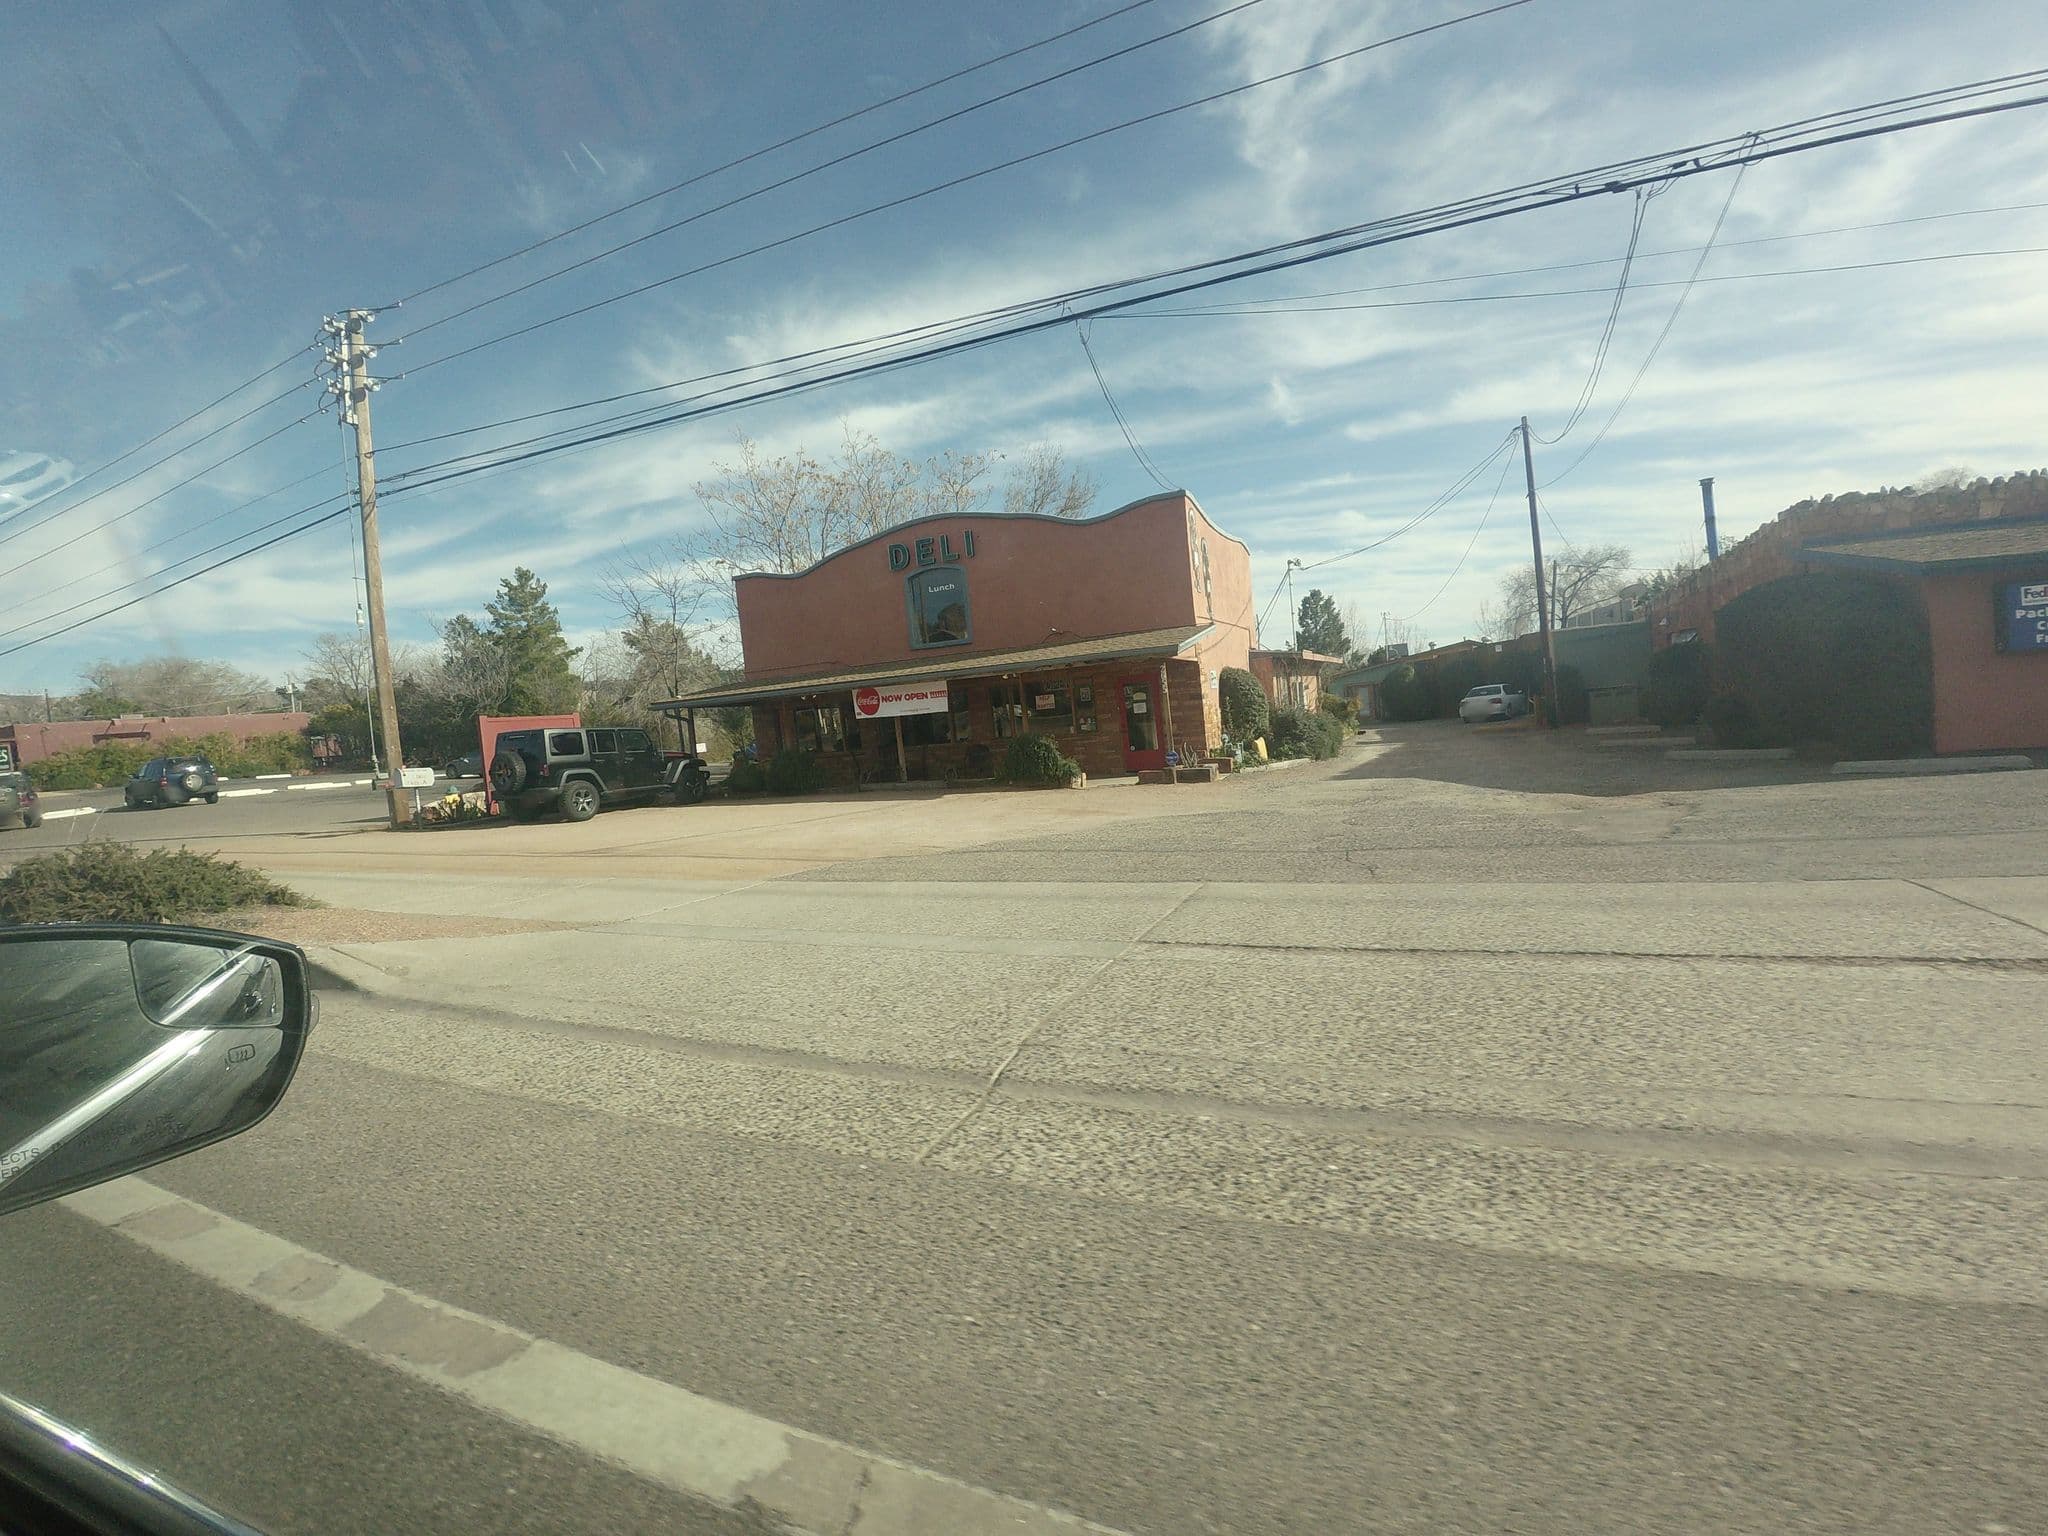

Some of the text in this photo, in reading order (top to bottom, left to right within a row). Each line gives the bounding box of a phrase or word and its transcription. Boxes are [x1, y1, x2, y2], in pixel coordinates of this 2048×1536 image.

[888, 529, 975, 571] DELI
[928, 583, 955, 593] Lunch
[881, 694, 902, 703] NOW
[904, 692, 928, 701] OPEN
